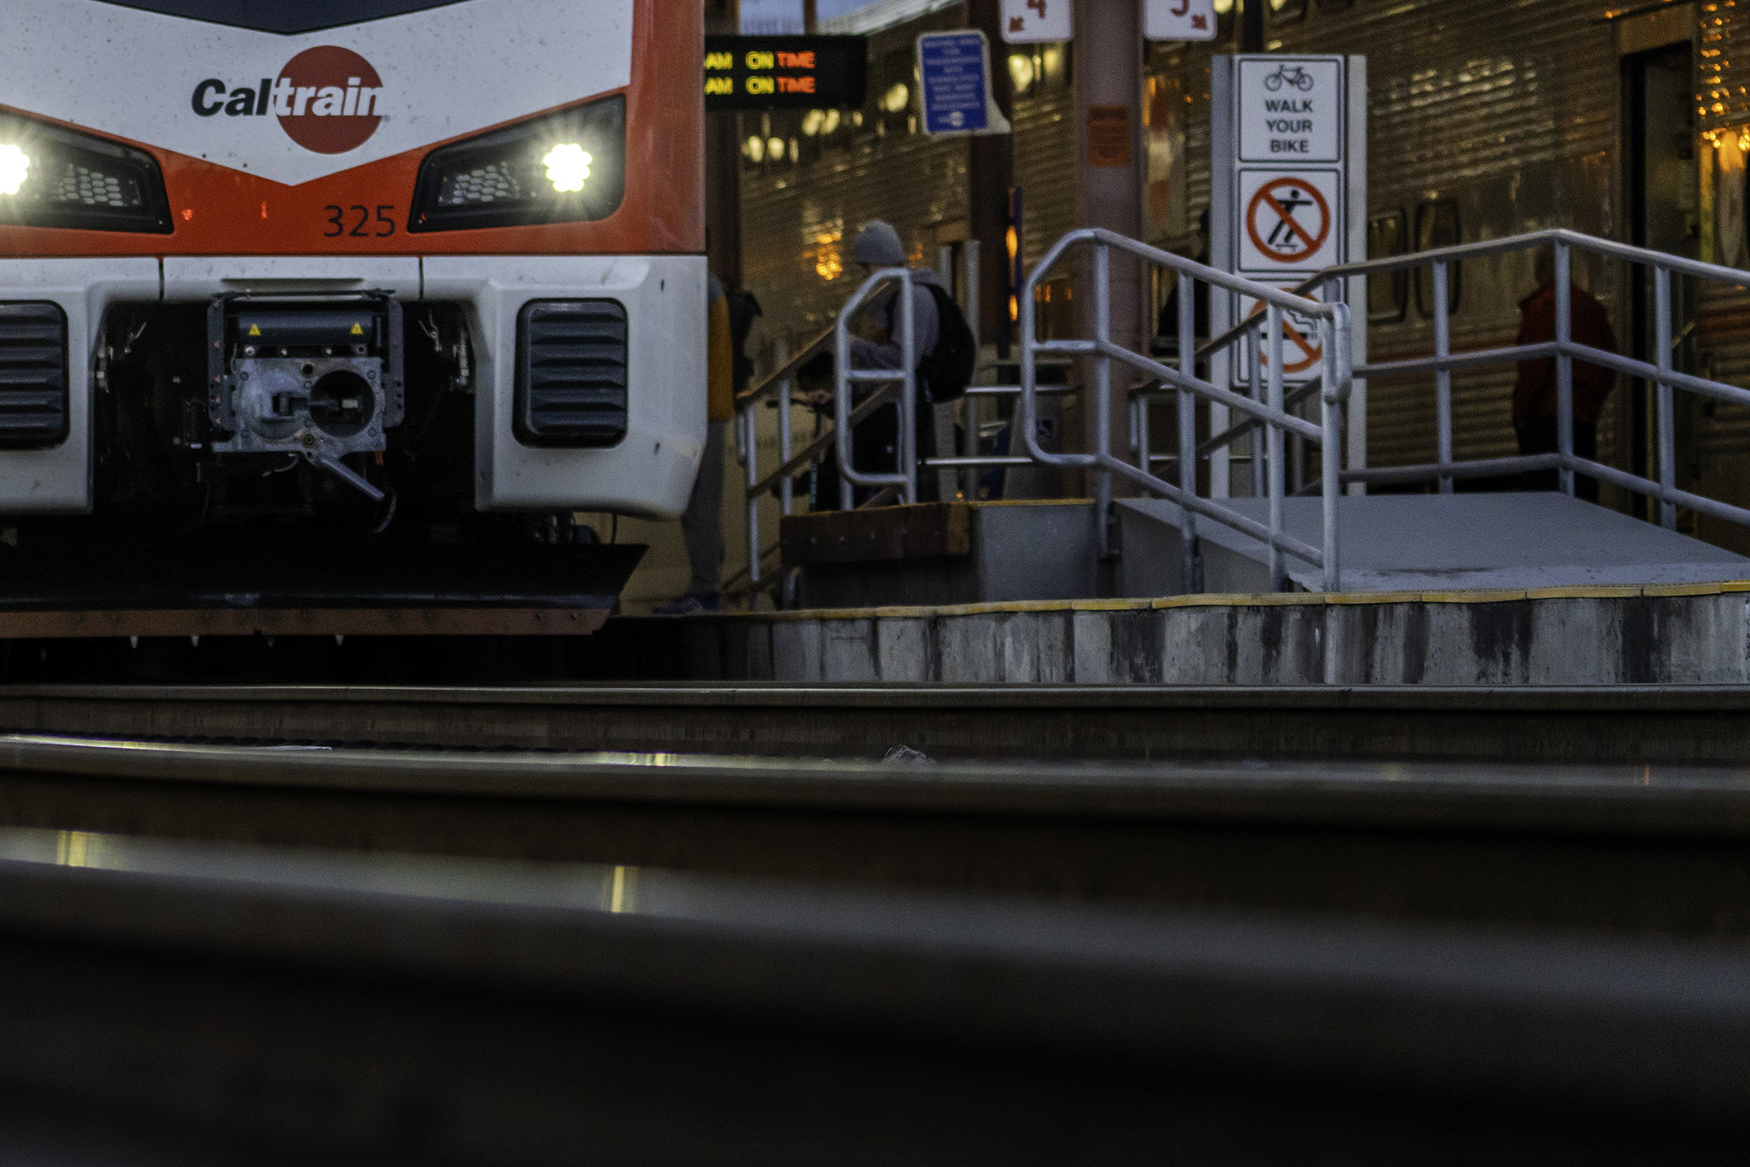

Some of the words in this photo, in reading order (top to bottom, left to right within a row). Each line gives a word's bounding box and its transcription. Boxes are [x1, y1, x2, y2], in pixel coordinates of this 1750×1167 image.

[745, 51, 774, 70] ON
[776, 51, 816, 69] TIME
[745, 76, 774, 95] ON
[776, 77, 816, 94] TIME
[191, 77, 384, 117] Caltrain
[1265, 100, 1313, 113] WALK
[1266, 120, 1313, 133] YOUR
[1271, 140, 1309, 153] BIKE
[323, 205, 395, 237] 325
